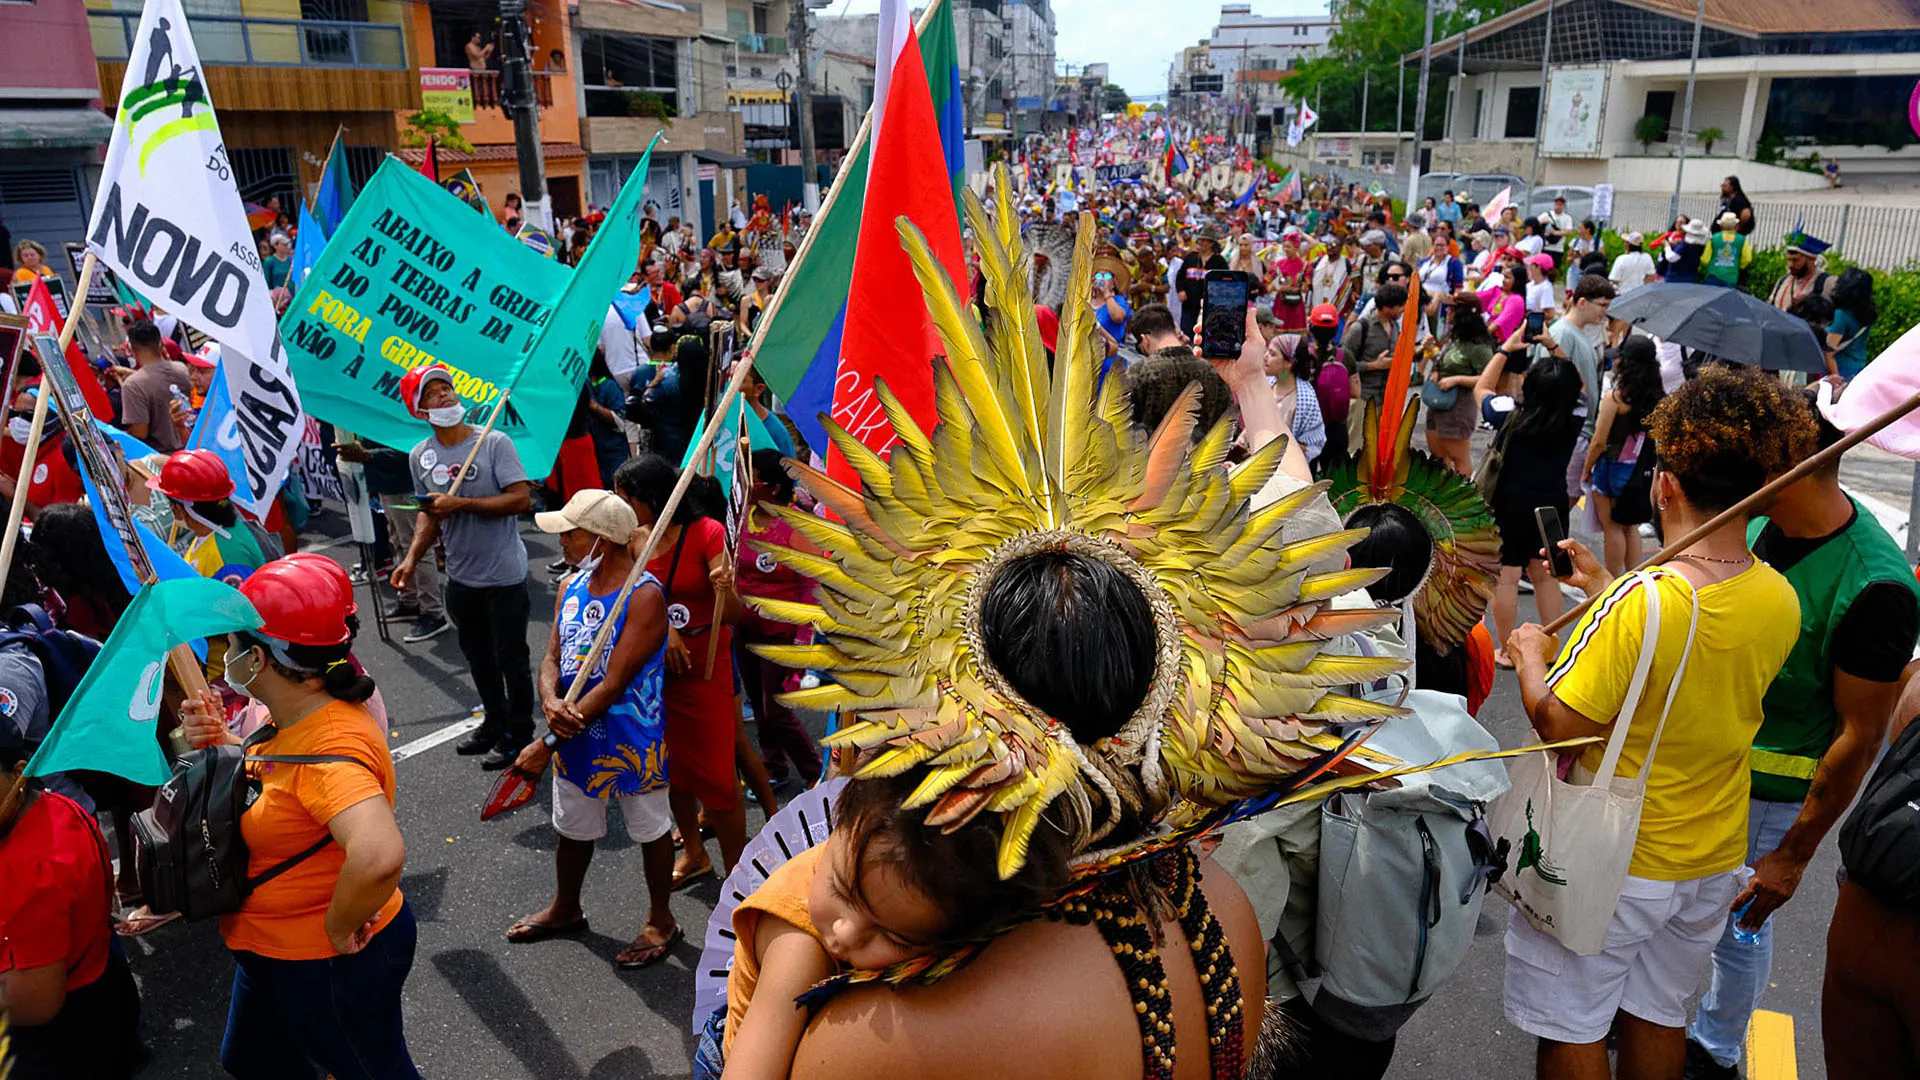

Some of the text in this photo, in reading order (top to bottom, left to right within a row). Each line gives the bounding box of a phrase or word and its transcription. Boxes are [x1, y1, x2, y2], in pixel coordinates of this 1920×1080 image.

[206, 155, 230, 181] DO
[92, 181, 250, 328] NOVO
[351, 236, 387, 268] AS
[389, 257, 477, 324] TERRAS
[479, 316, 515, 344] DA
[372, 207, 456, 273] ABAIXO
[461, 267, 483, 292] A
[307, 289, 374, 344] FORA
[329, 262, 441, 346] DO POVO.
[287, 318, 337, 361] NÃO
[341, 348, 365, 380] À
